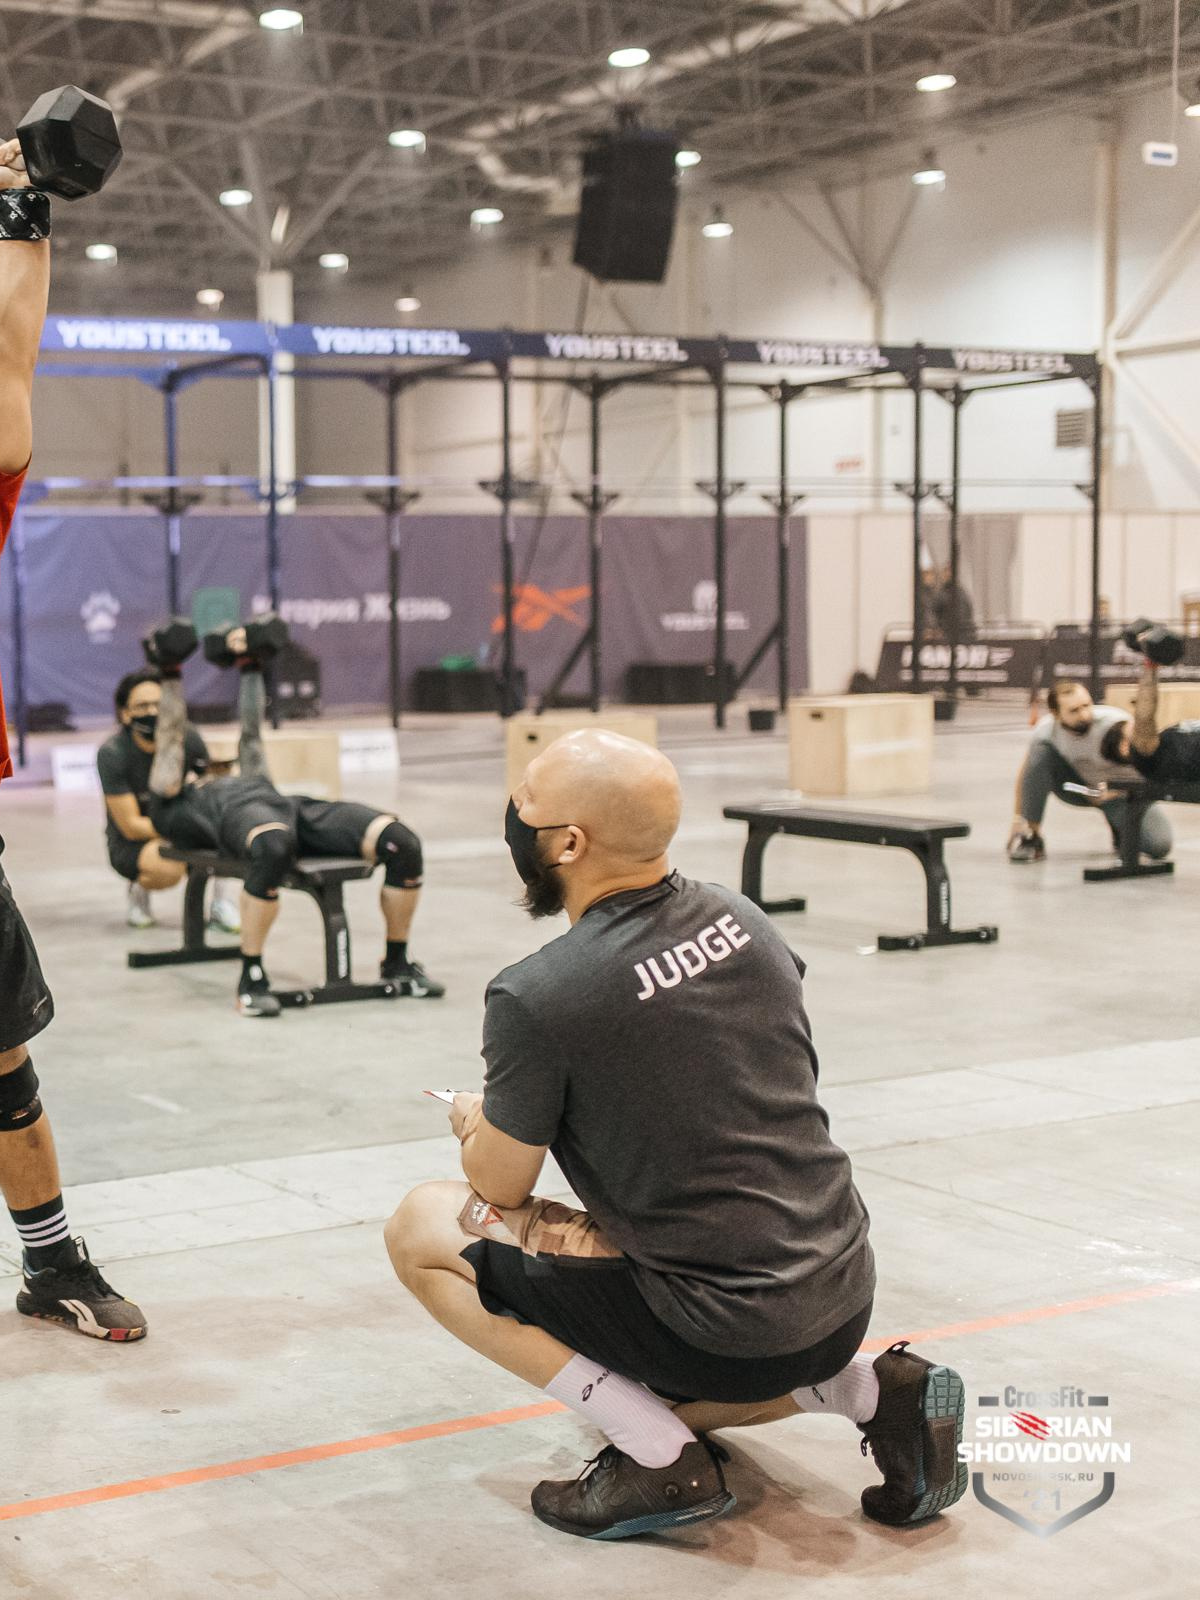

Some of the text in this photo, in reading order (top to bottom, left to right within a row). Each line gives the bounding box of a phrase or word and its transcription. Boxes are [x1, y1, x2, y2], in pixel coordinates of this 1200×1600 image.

[56, 319, 232, 351] YOUSTEEL
[312, 326, 471, 356] YOUSTEEL
[545, 333, 689, 362] YOUSTEEL
[756, 340, 890, 368] YOUSTEEL
[953, 349, 1073, 374] YOUSTEEL
[633, 913, 752, 1001] JUDGE
